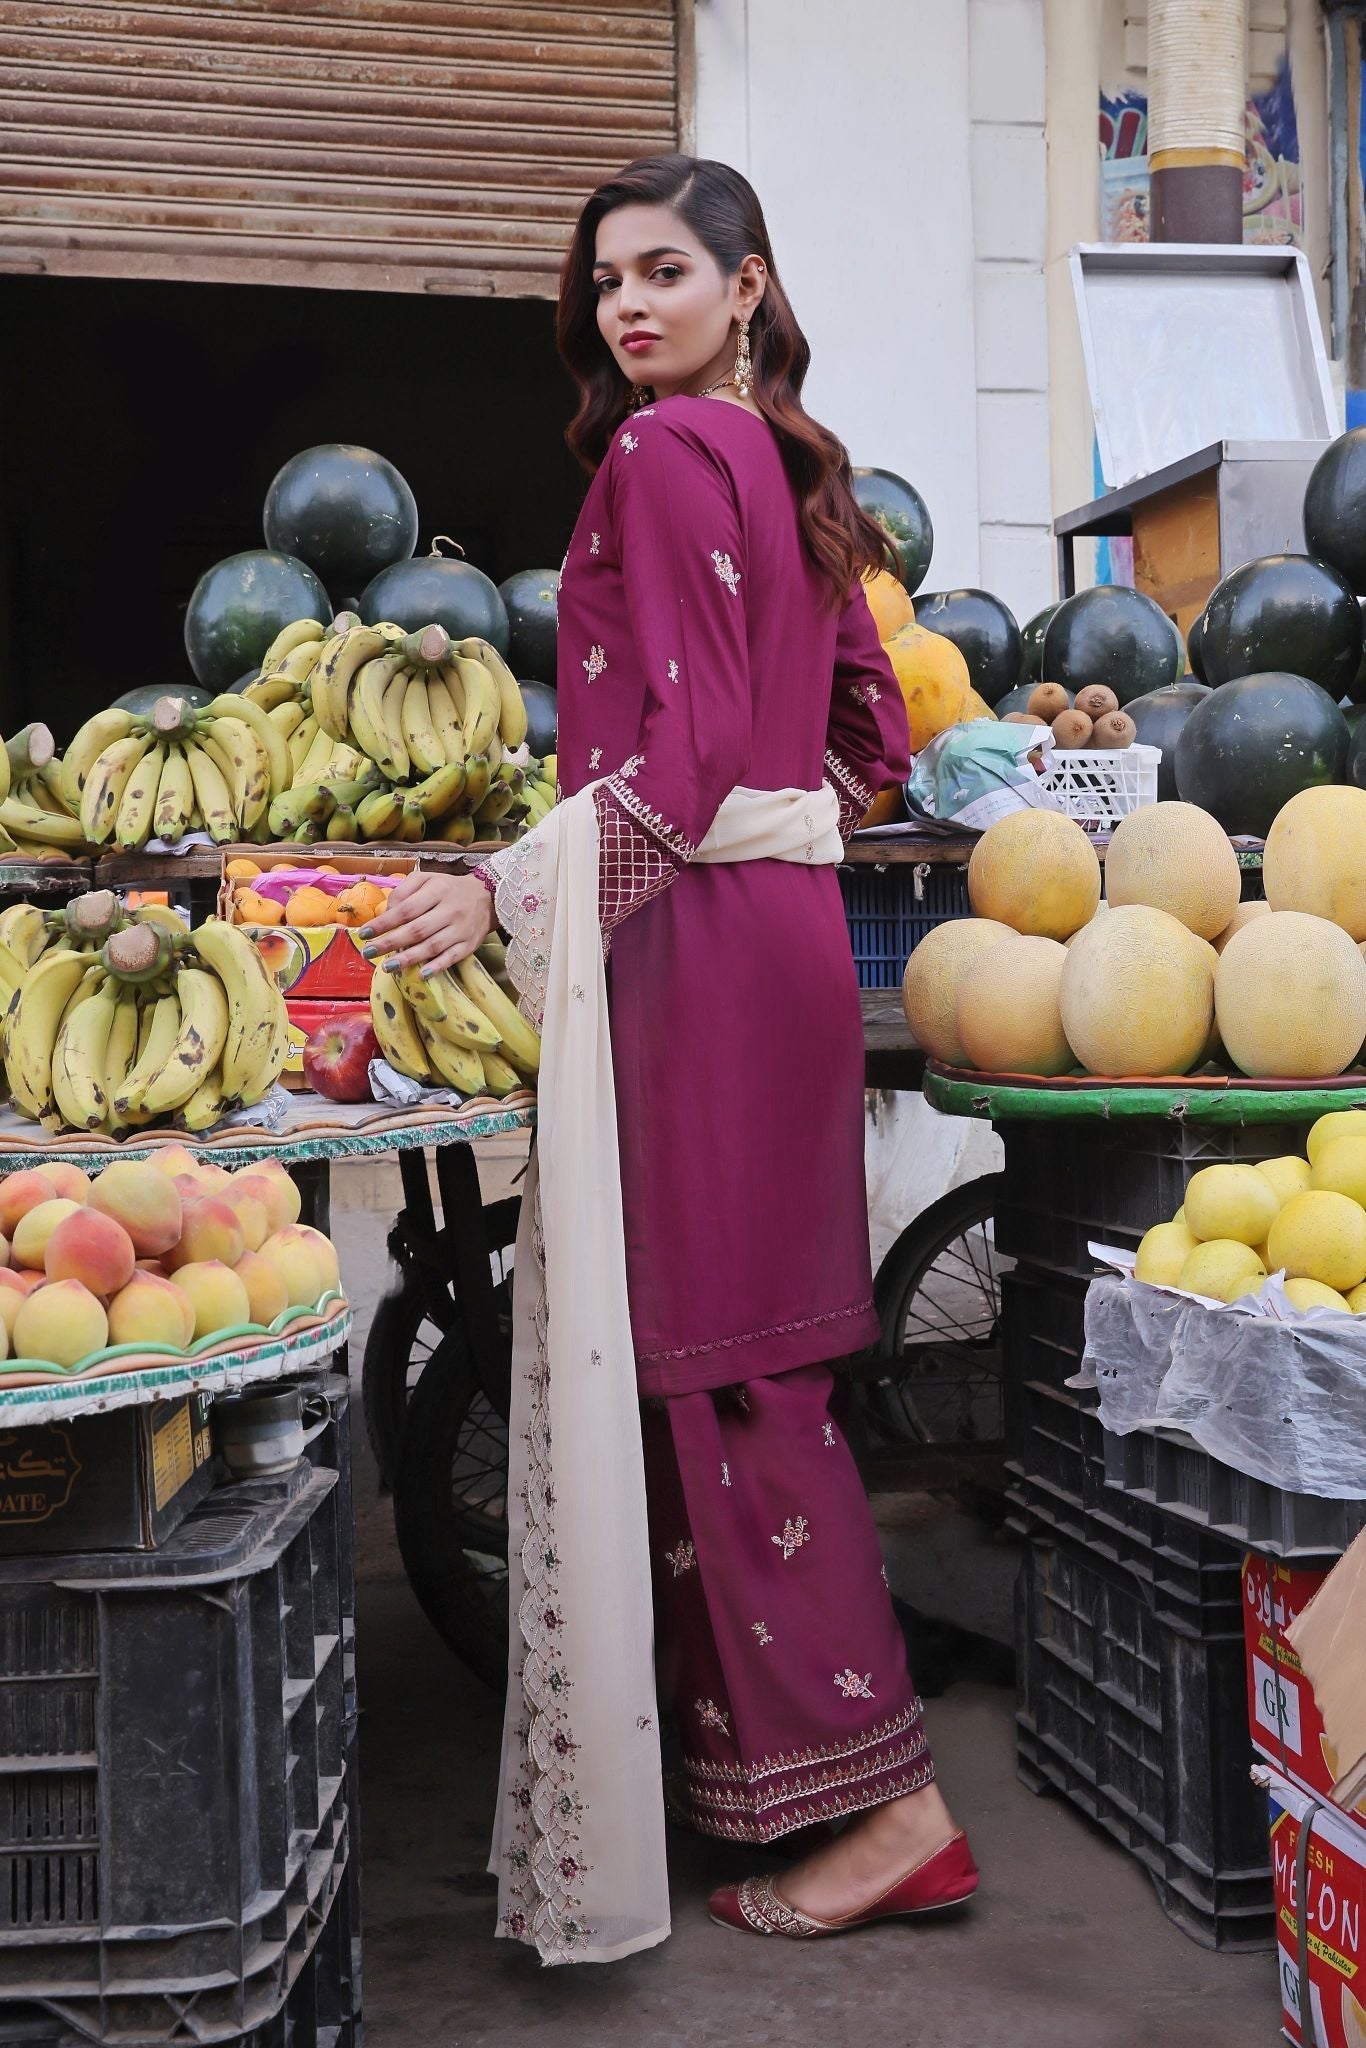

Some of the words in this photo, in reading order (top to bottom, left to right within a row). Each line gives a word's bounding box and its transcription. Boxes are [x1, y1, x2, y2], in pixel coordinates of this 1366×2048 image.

[0, 1493, 46, 1512] ATE
[1263, 1678, 1290, 1728] GR
[1289, 1830, 1334, 1878] FESH
[1313, 1941, 1321, 1956] of
[1322, 1944, 1352, 1975] Pakistan
